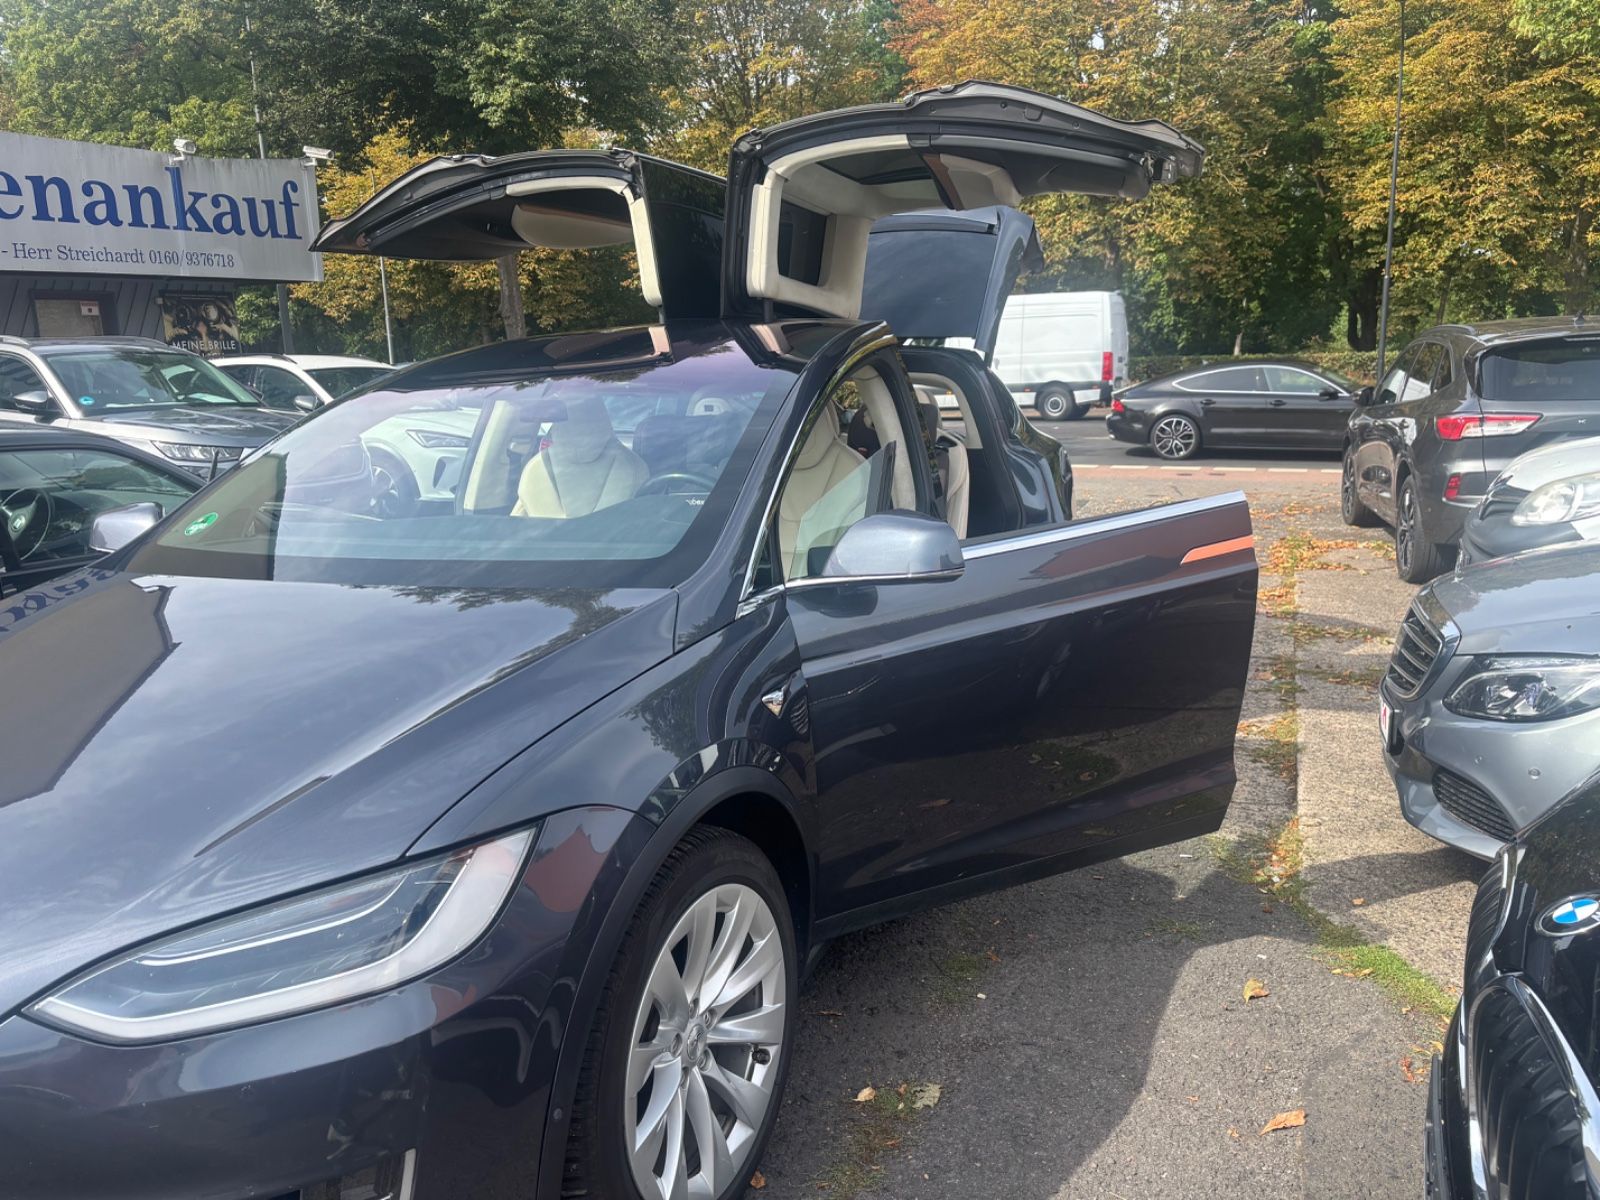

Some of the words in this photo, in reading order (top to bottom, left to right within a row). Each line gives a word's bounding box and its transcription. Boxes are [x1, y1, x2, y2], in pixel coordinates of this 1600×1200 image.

[12, 242, 53, 260] Herr
[56, 244, 146, 264] Streichardt
[208, 340, 236, 350] BRILLE
